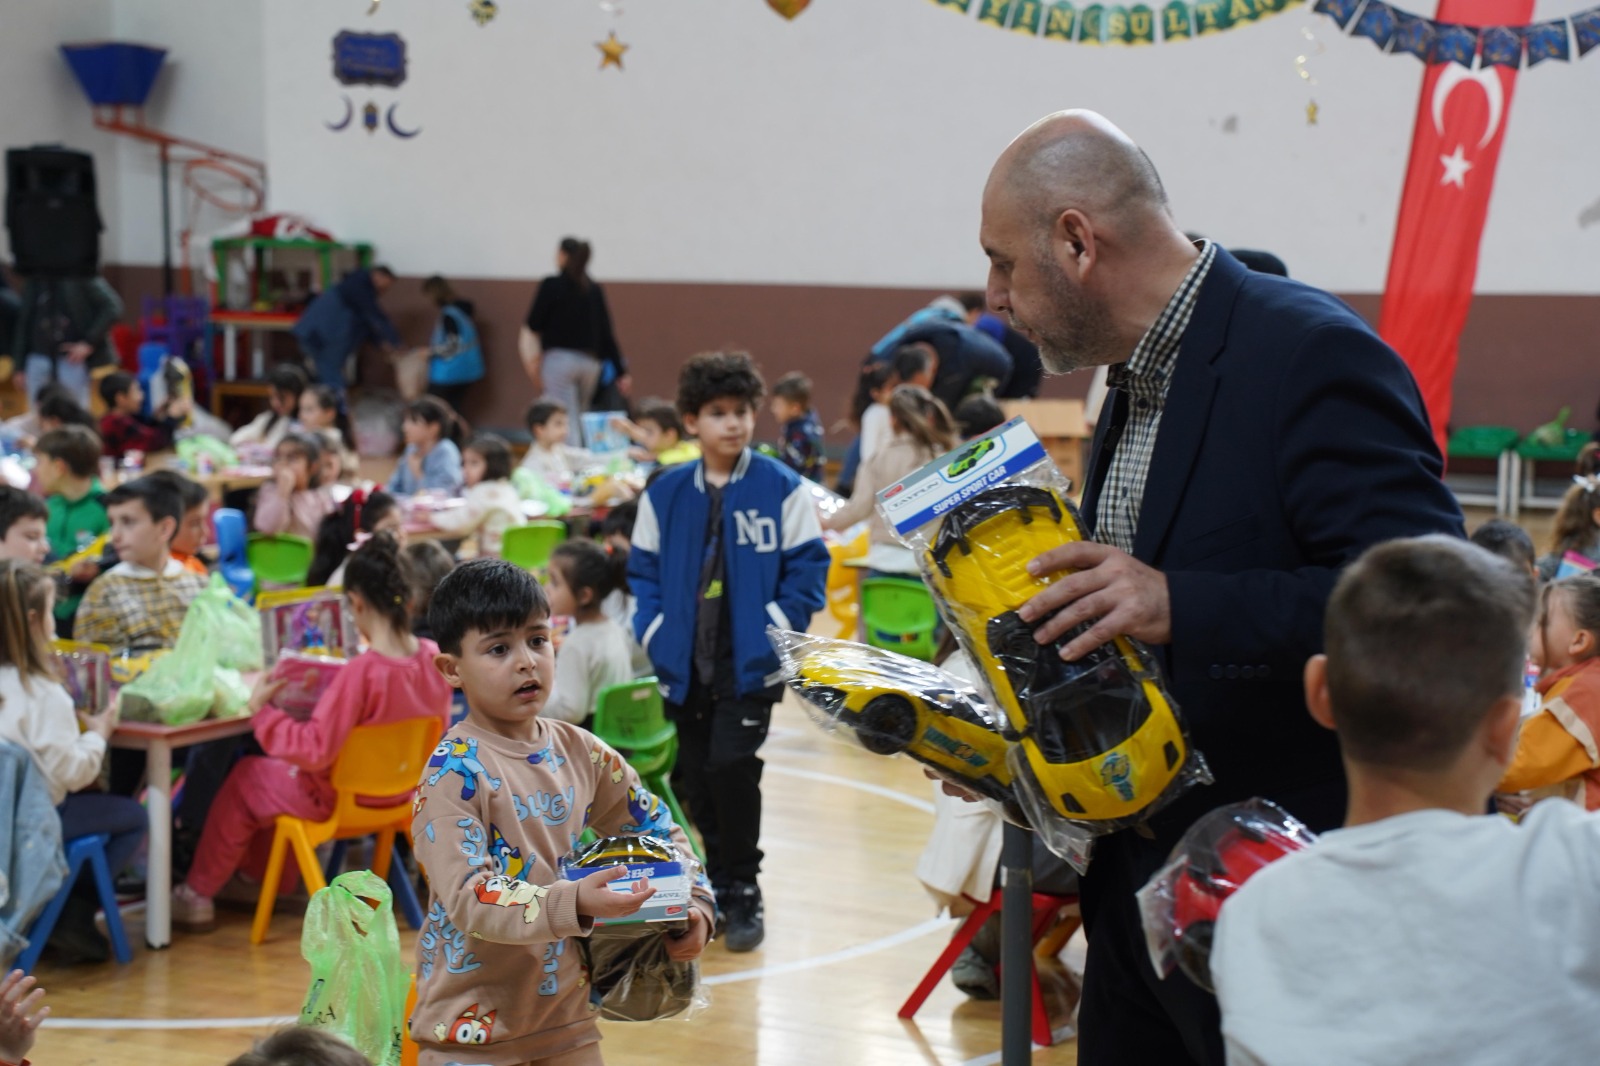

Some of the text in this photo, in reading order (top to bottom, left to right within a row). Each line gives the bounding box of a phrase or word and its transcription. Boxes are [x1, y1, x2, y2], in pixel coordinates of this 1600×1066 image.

[932, 465, 1007, 514] SUPER SPORT CAR
[733, 509, 777, 552] ND
[511, 785, 575, 827] BLUEY
